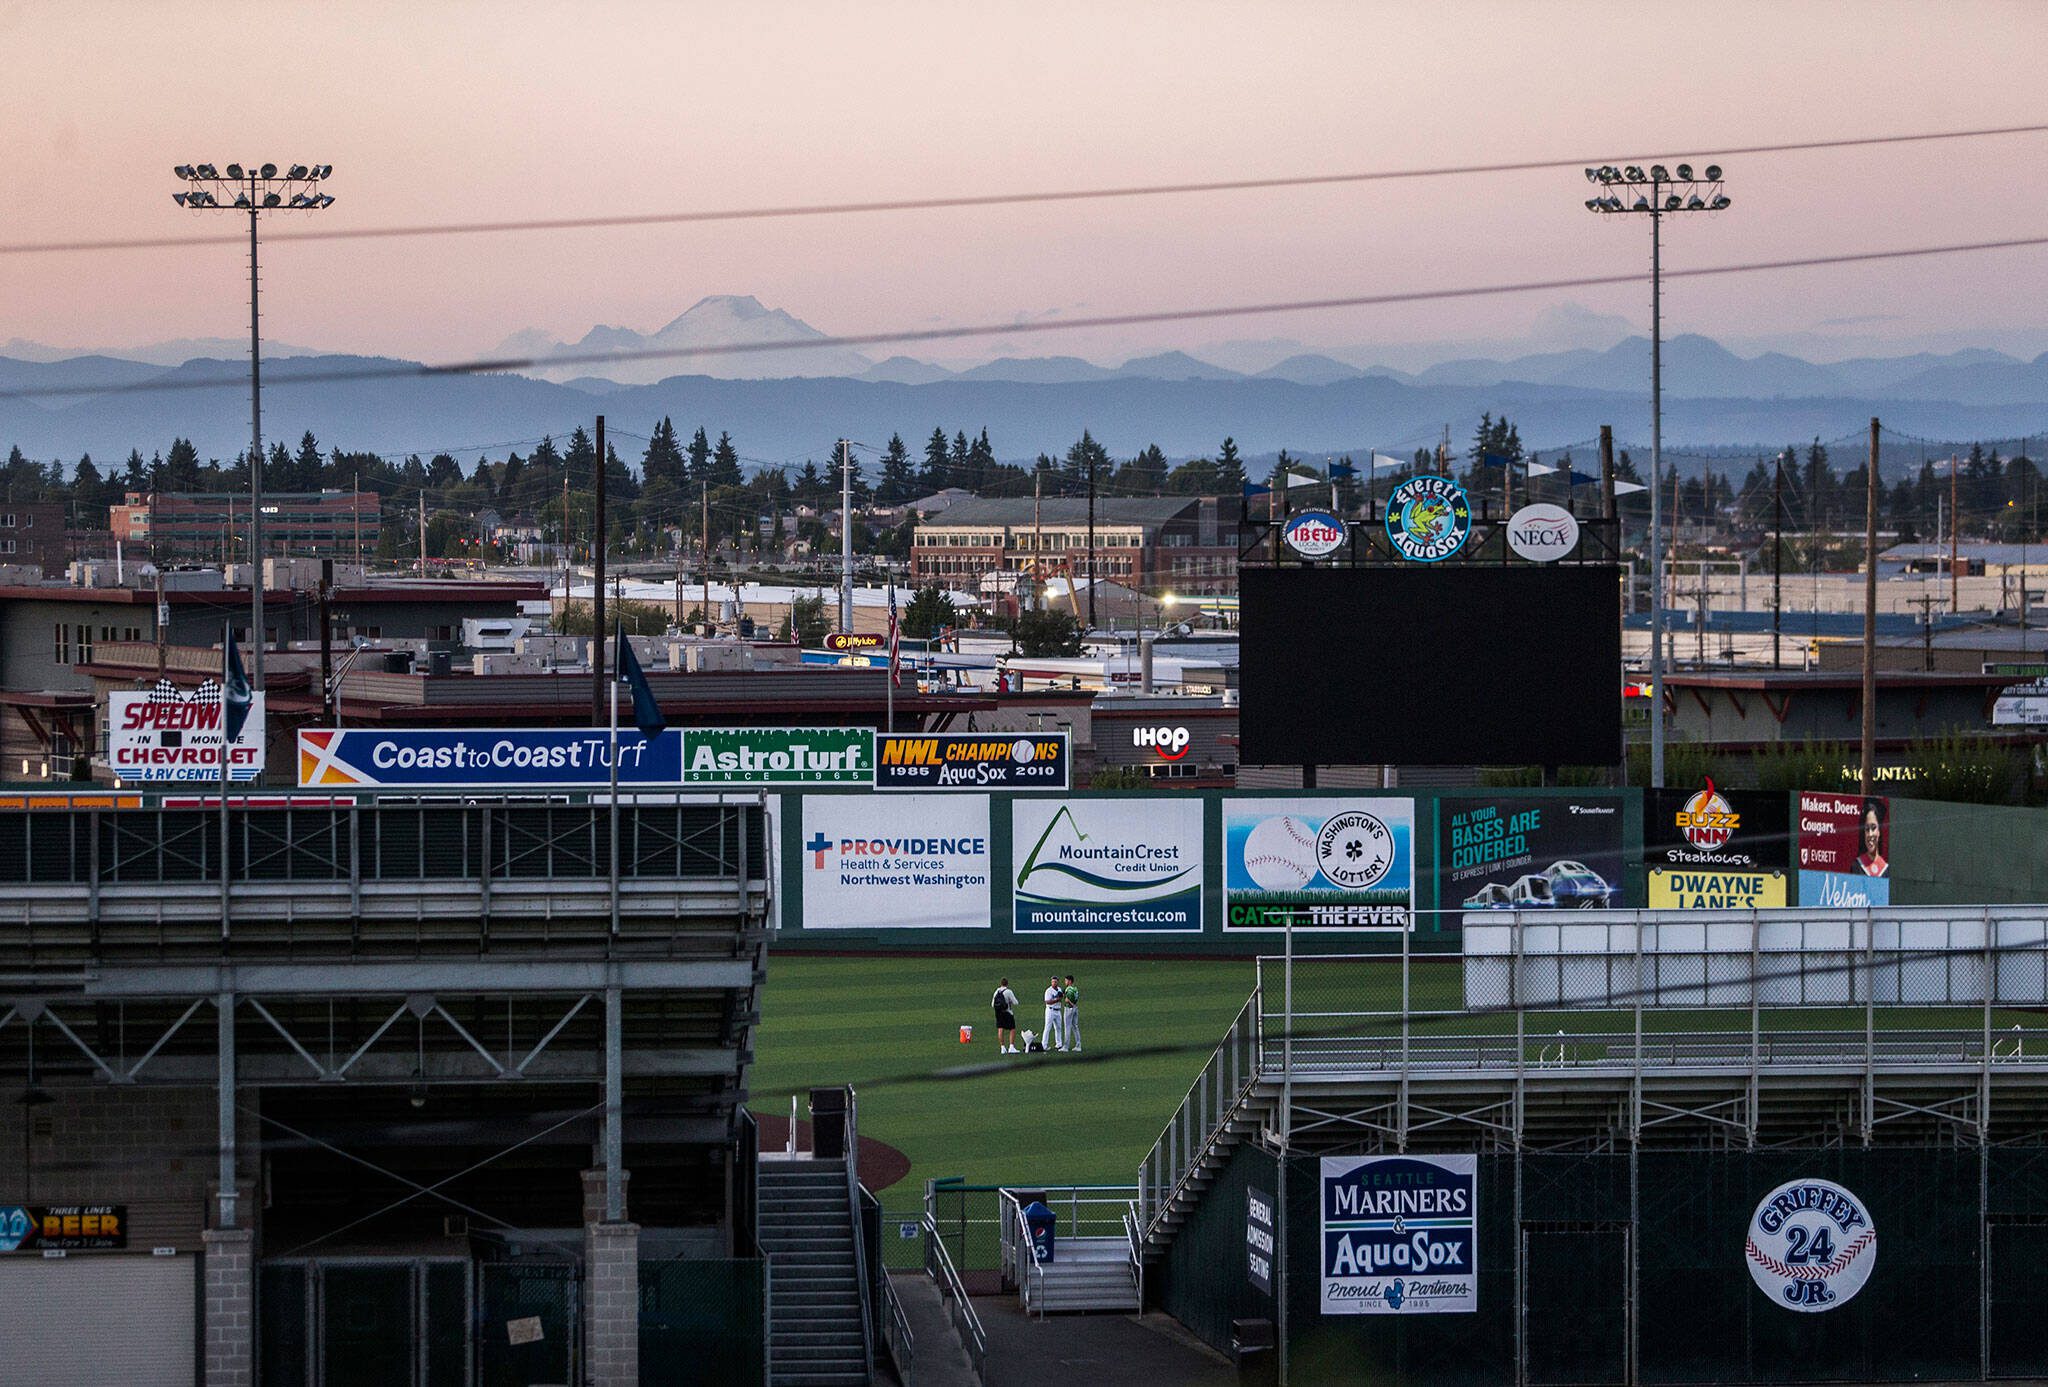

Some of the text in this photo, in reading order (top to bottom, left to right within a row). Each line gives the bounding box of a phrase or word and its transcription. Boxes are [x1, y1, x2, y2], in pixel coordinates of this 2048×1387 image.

[1396, 479, 1462, 504] Everett
[1294, 527, 1337, 542] IBEW
[1392, 527, 1466, 559] AquaSox
[1513, 530, 1567, 546] NECA
[137, 736, 151, 744] IN
[881, 739, 943, 765] NWL
[144, 768, 154, 780] &
[156, 768, 174, 780] RV
[800, 773, 860, 781] 1965
[890, 763, 1055, 785] 1985 AquaSox 2010
[1801, 797, 1860, 815] Makers. Doers.
[1452, 806, 1496, 827] ALL YOUR
[1675, 811, 1740, 828] BUZZ
[1452, 809, 1541, 849] BASES ARE
[1689, 828, 1728, 844] INN
[1801, 817, 1836, 836] Cougars.
[841, 838, 985, 855] PROVIDENCE
[1322, 817, 1384, 859] WASHINGTON'S
[1059, 844, 1179, 859] MountainCrest
[1453, 835, 1530, 869] COVERED.
[1666, 849, 1751, 865] Steakhouse
[1811, 849, 1836, 863] EVERETT
[841, 858, 944, 869] Health & Services
[1115, 863, 1179, 872] Credit Union
[1332, 854, 1385, 883] LOTTERY
[841, 874, 985, 889] Northwest Washington
[1670, 874, 1764, 895] DWAYNE
[1031, 909, 1187, 923] mountaincrestcu.com
[1309, 906, 1345, 925] THE
[1361, 1172, 1435, 1185] SEATTLE
[1335, 1185, 1467, 1215] MARINERS
[1758, 1184, 1866, 1235] GRIFFEY
[1249, 1198, 1272, 1227] GENERAL
[43, 1215, 120, 1237] BEER
[1392, 1215, 1406, 1235] &
[1246, 1224, 1273, 1255] ADMISSION
[1785, 1225, 1835, 1266] 24
[1332, 1231, 1463, 1275] AquaSox
[1249, 1252, 1269, 1281] SEATING
[1327, 1279, 1472, 1298] Proud Partners
[1783, 1278, 1836, 1306] JR.
